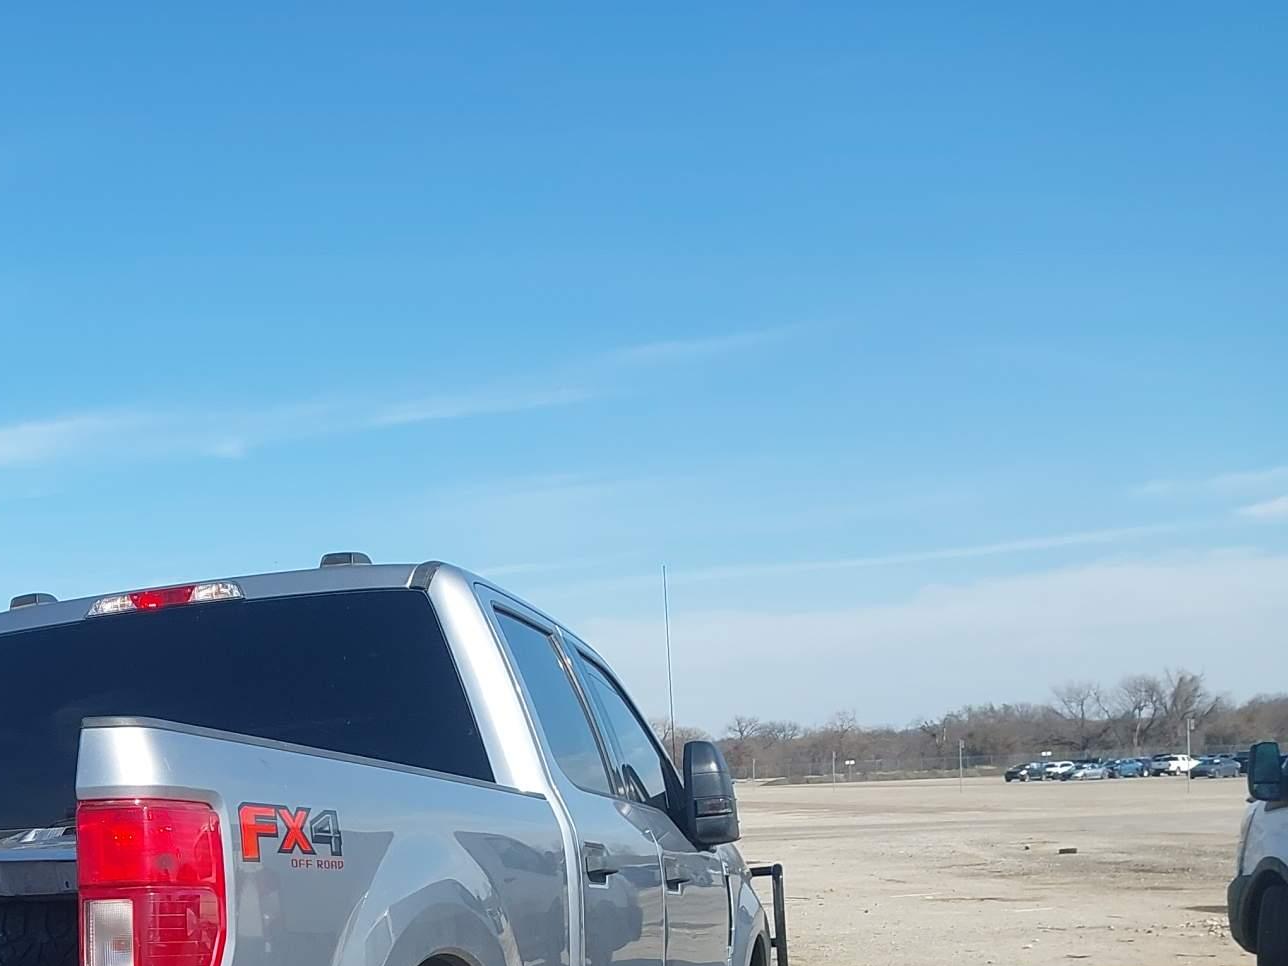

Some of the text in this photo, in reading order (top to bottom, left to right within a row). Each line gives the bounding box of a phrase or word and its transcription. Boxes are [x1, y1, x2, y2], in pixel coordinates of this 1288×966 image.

[237, 801, 343, 863] FX4
[291, 858, 344, 870] OFF ROAD
